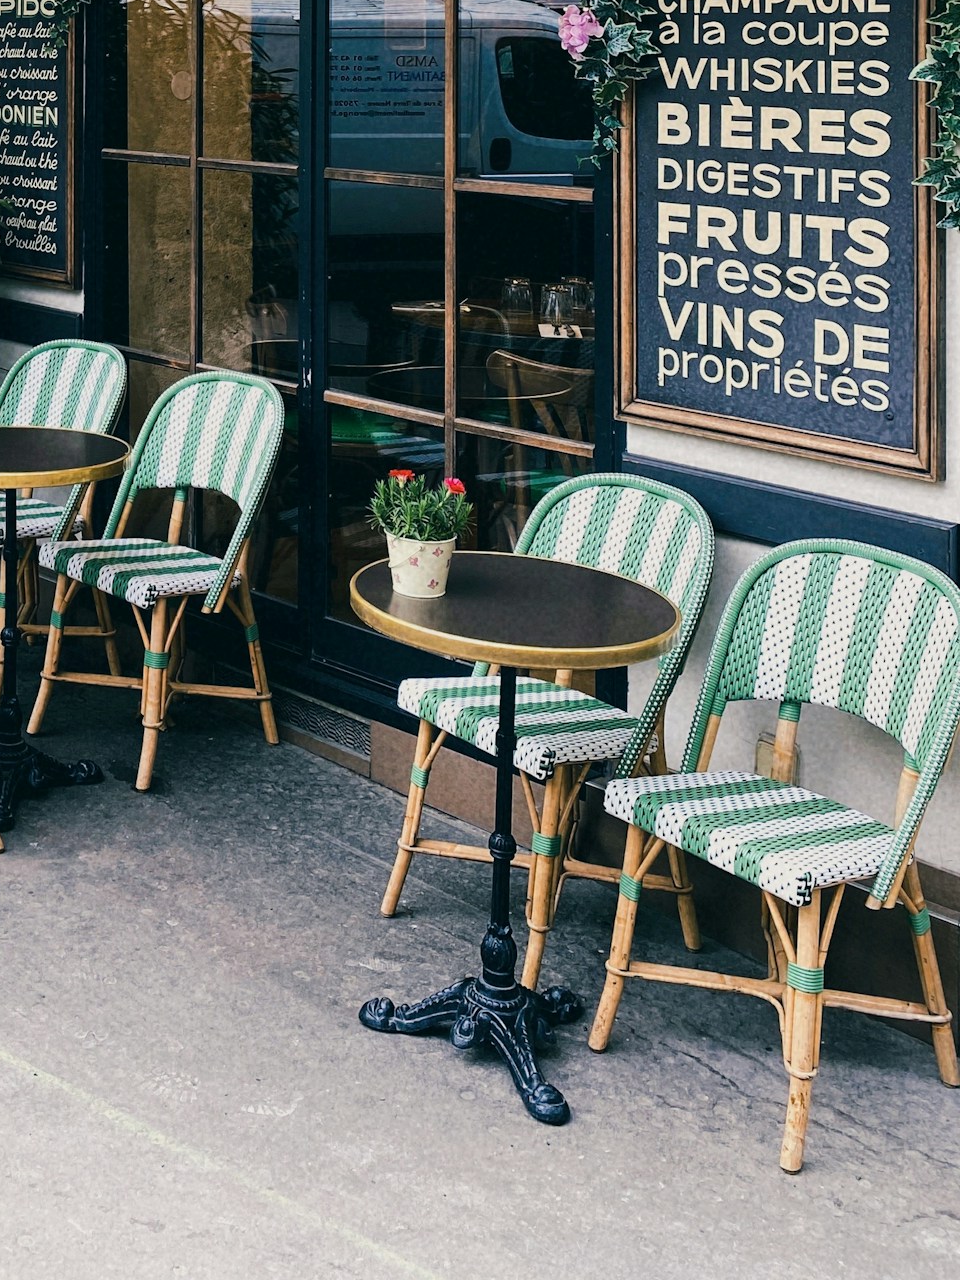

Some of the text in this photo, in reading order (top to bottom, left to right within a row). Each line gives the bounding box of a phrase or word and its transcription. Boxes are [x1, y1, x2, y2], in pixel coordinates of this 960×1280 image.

[18, 27, 33, 38] au
[658, 14, 890, 56] à la coupe
[26, 48, 38, 58] ou
[9, 63, 58, 80] croissant
[658, 57, 890, 97] WHISKIES
[13, 136, 28, 147] au
[31, 130, 58, 149] lait
[657, 96, 892, 158] BIÈRES
[25, 157, 38, 169] ou
[38, 151, 58, 170] thé
[12, 172, 58, 191] croissant
[657, 157, 891, 208] DIGESTIFS
[38, 215, 58, 234] plat
[657, 201, 890, 268] FRUITS
[5, 230, 57, 255] brouillés
[657, 251, 891, 313] pressés
[657, 297, 890, 373] VINS DE
[657, 347, 890, 412] propriétés
